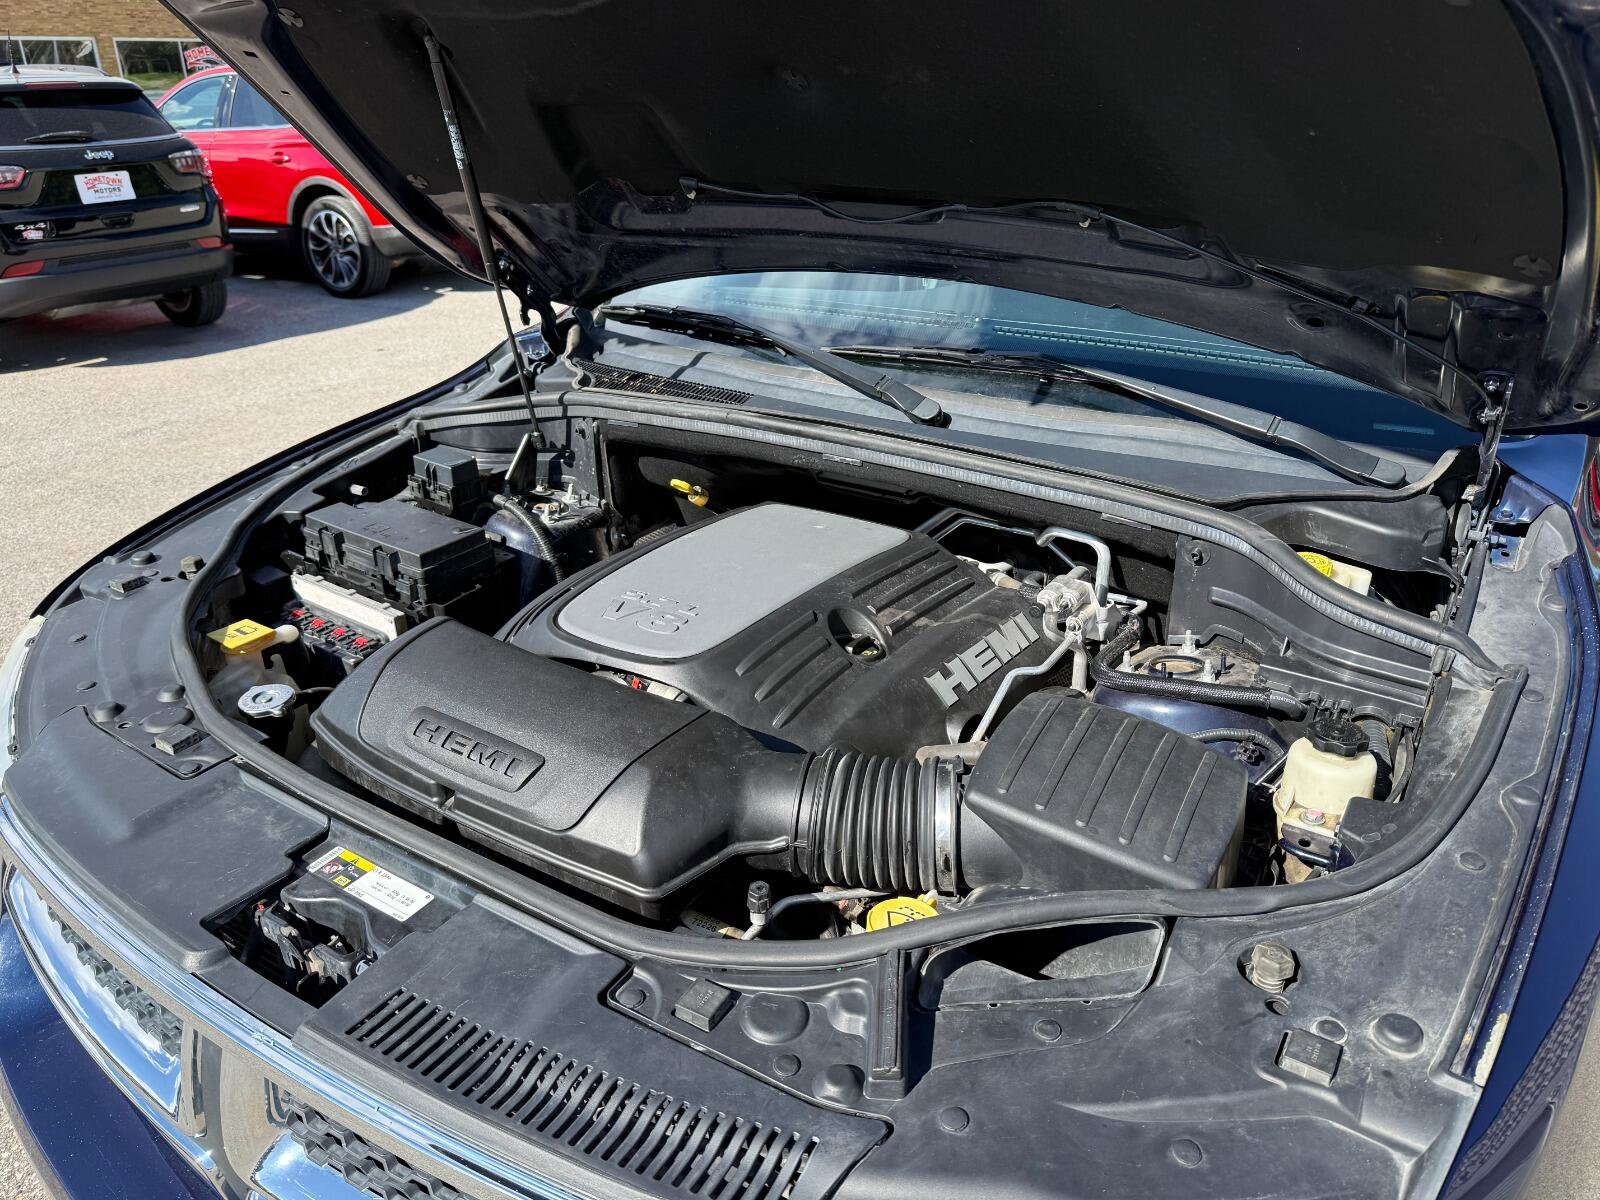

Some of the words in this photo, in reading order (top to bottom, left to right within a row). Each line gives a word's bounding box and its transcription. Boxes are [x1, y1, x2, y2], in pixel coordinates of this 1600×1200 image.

[84, 150, 115, 160] Jeep
[84, 175, 123, 188] HOMETOWN
[600, 599, 691, 636] V8
[923, 609, 1040, 710] HEMI
[412, 717, 523, 780] HEMI
